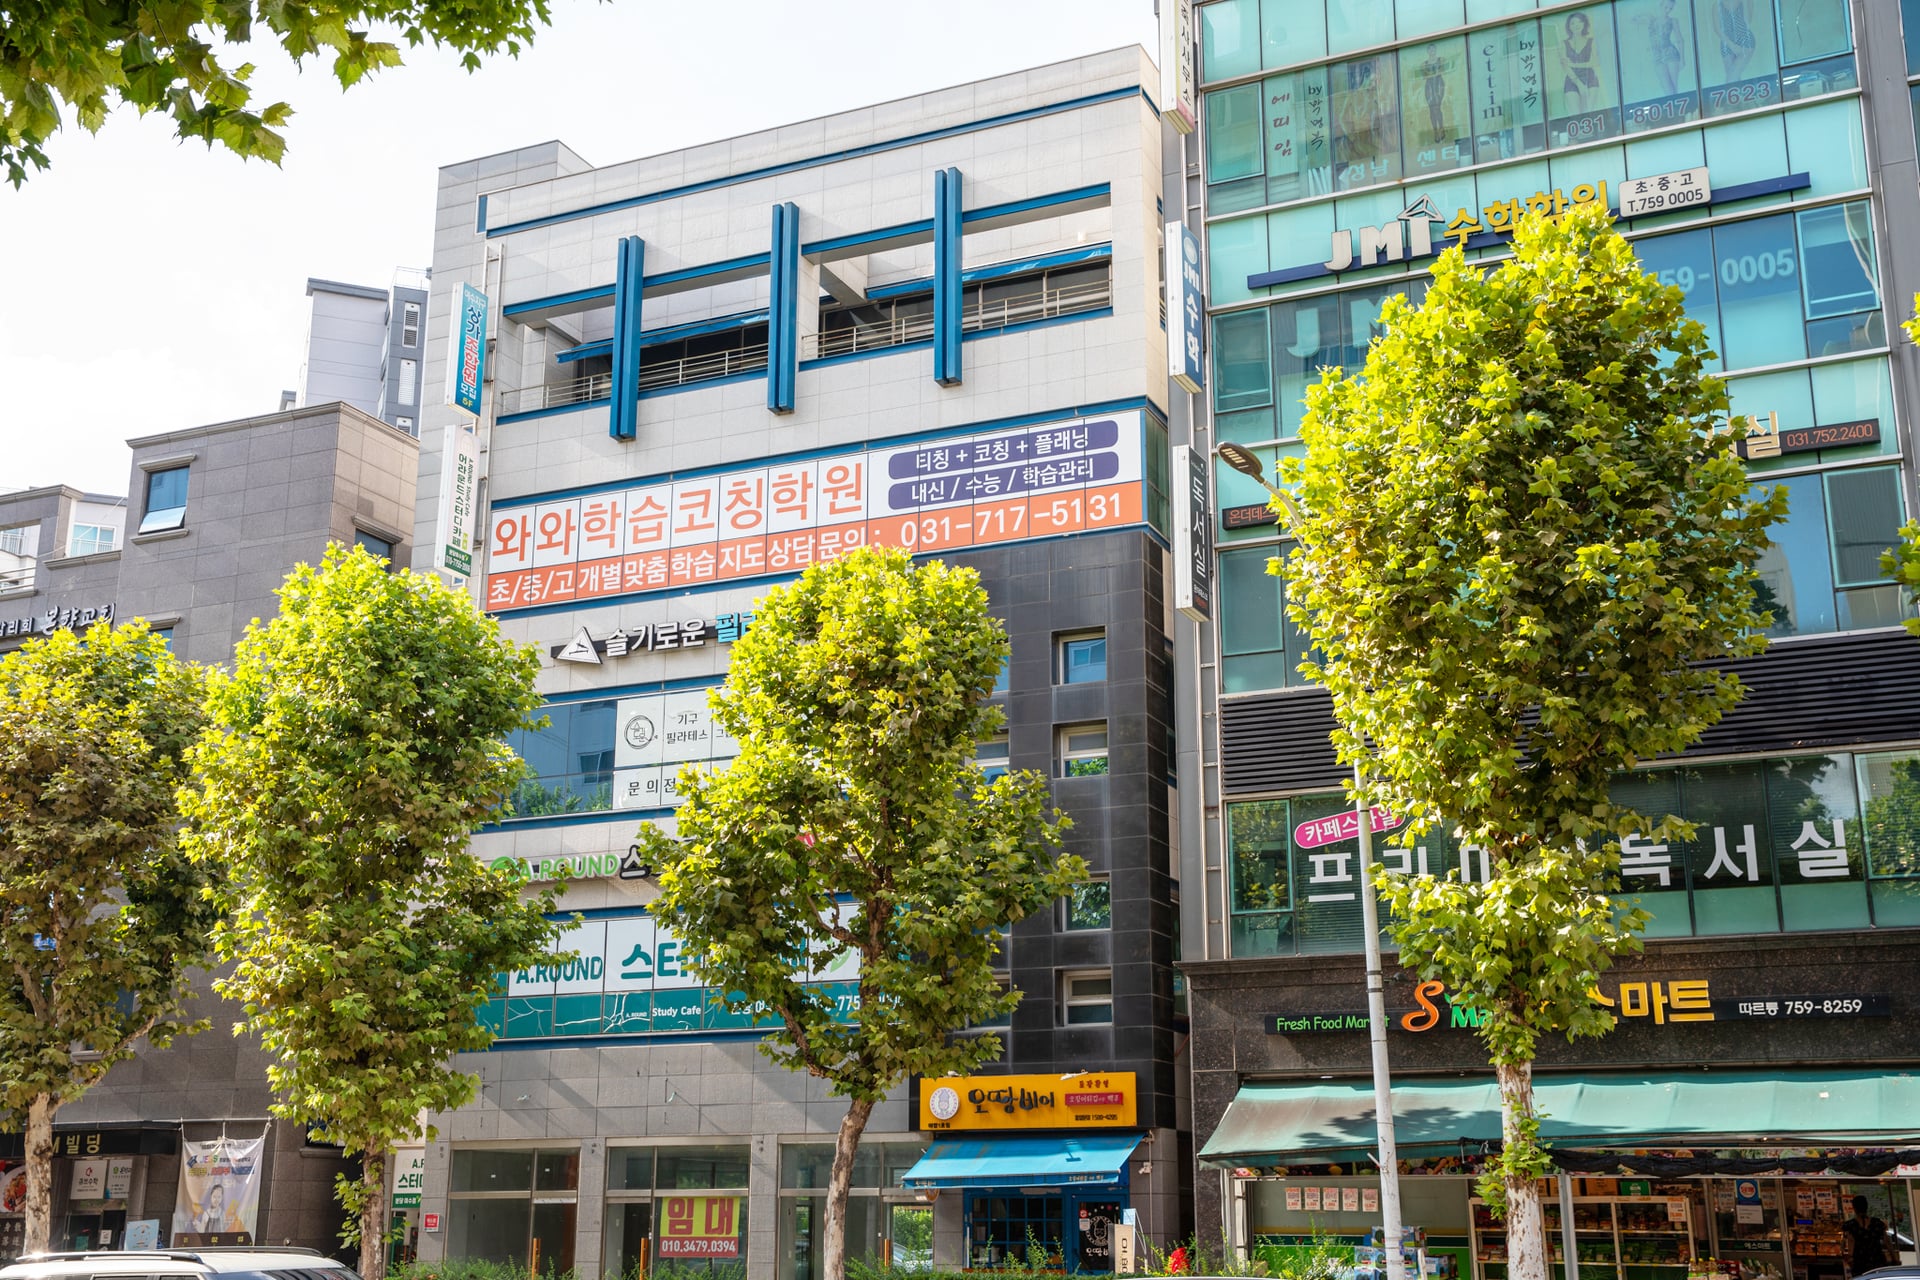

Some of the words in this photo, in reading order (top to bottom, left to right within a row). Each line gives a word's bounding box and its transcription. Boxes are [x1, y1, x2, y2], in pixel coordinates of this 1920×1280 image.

[1520, 39, 1535, 51] by
[1308, 85, 1322, 96] by
[1482, 44, 1503, 120] ettim
[1568, 114, 1605, 139] 031
[1633, 98, 1689, 124] 8017
[1710, 81, 1771, 109] 7623
[1348, 159, 1389, 181] 성남
[1417, 145, 1459, 167] 센터
[1627, 196, 1664, 213] T.759
[1668, 188, 1704, 206] 0005
[1324, 216, 1432, 271] JMI
[1184, 261, 1199, 291] JMI
[1185, 294, 1200, 373] 수학
[460, 383, 477, 400] 모집
[916, 448, 950, 472] 티칭
[973, 439, 1010, 464] 코칭
[1034, 428, 1090, 453] 플래닝
[1786, 422, 1874, 447] 031.752.2400
[911, 480, 945, 503] 내신
[966, 472, 1001, 496] 수능
[1022, 457, 1094, 486] 학습관리
[452, 452, 469, 549] 어라운드스터디카페
[491, 461, 864, 562] 와와학습코칭학원
[900, 492, 1122, 547] 031-717-5131
[1192, 475, 1207, 579] 독서실
[40, 603, 116, 635] 본향교회
[605, 618, 707, 657] 슬기로운
[678, 713, 698, 725] 기구
[667, 729, 708, 744] 필라테스
[516, 956, 603, 985] A.ROUND
[652, 1007, 678, 1018] Study
[680, 1006, 702, 1016] Cafe
[1277, 1017, 1311, 1032] Fresh
[1313, 1015, 1343, 1030] Food
[1345, 1015, 1390, 1029] Mart
[1739, 1002, 1779, 1016] 따르릉
[1785, 999, 1863, 1015] 759-8259
[667, 1198, 733, 1236] 임대
[661, 1238, 736, 1254] 010.3479.0394
